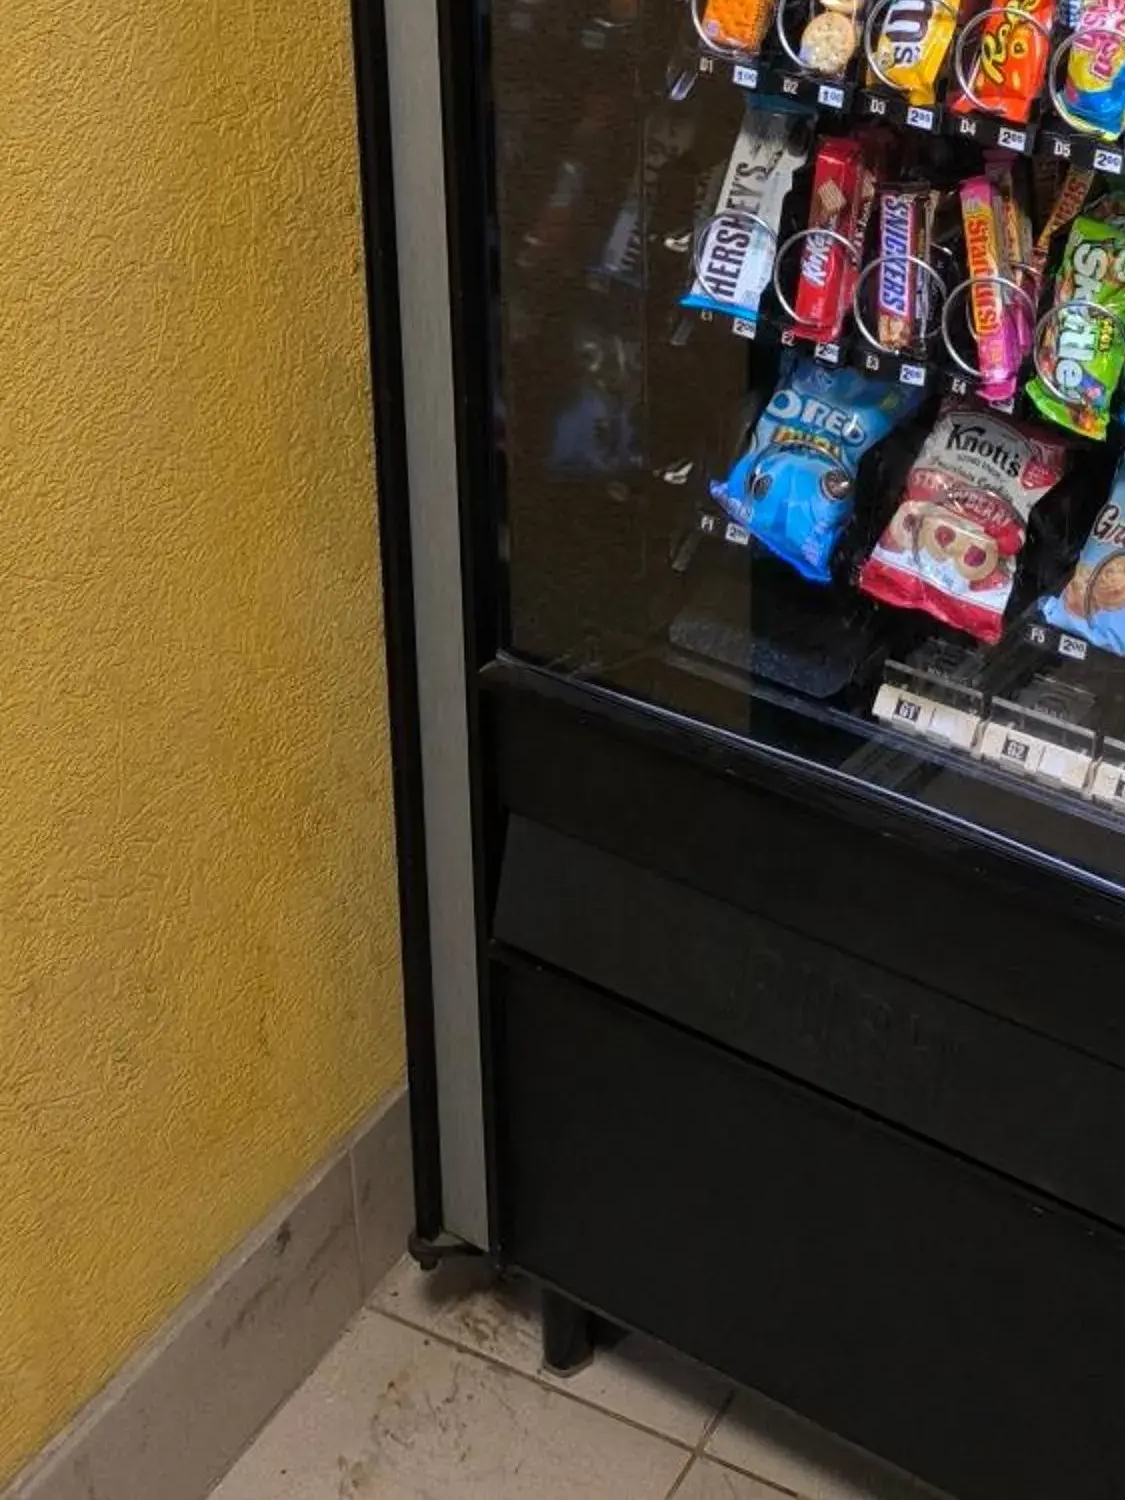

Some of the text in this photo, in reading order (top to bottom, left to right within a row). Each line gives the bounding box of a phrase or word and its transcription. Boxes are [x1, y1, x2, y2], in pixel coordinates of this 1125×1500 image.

[870, 99, 886, 115] D3
[960, 120, 977, 136] D4
[1054, 141, 1071, 158] D5
[702, 161, 769, 298] HERSHEY'S
[883, 194, 910, 314] SNICKERS
[952, 379, 967, 395] E4
[765, 388, 869, 445] OREO
[945, 422, 1023, 477] Knott's
[1030, 626, 1045, 643] F5
